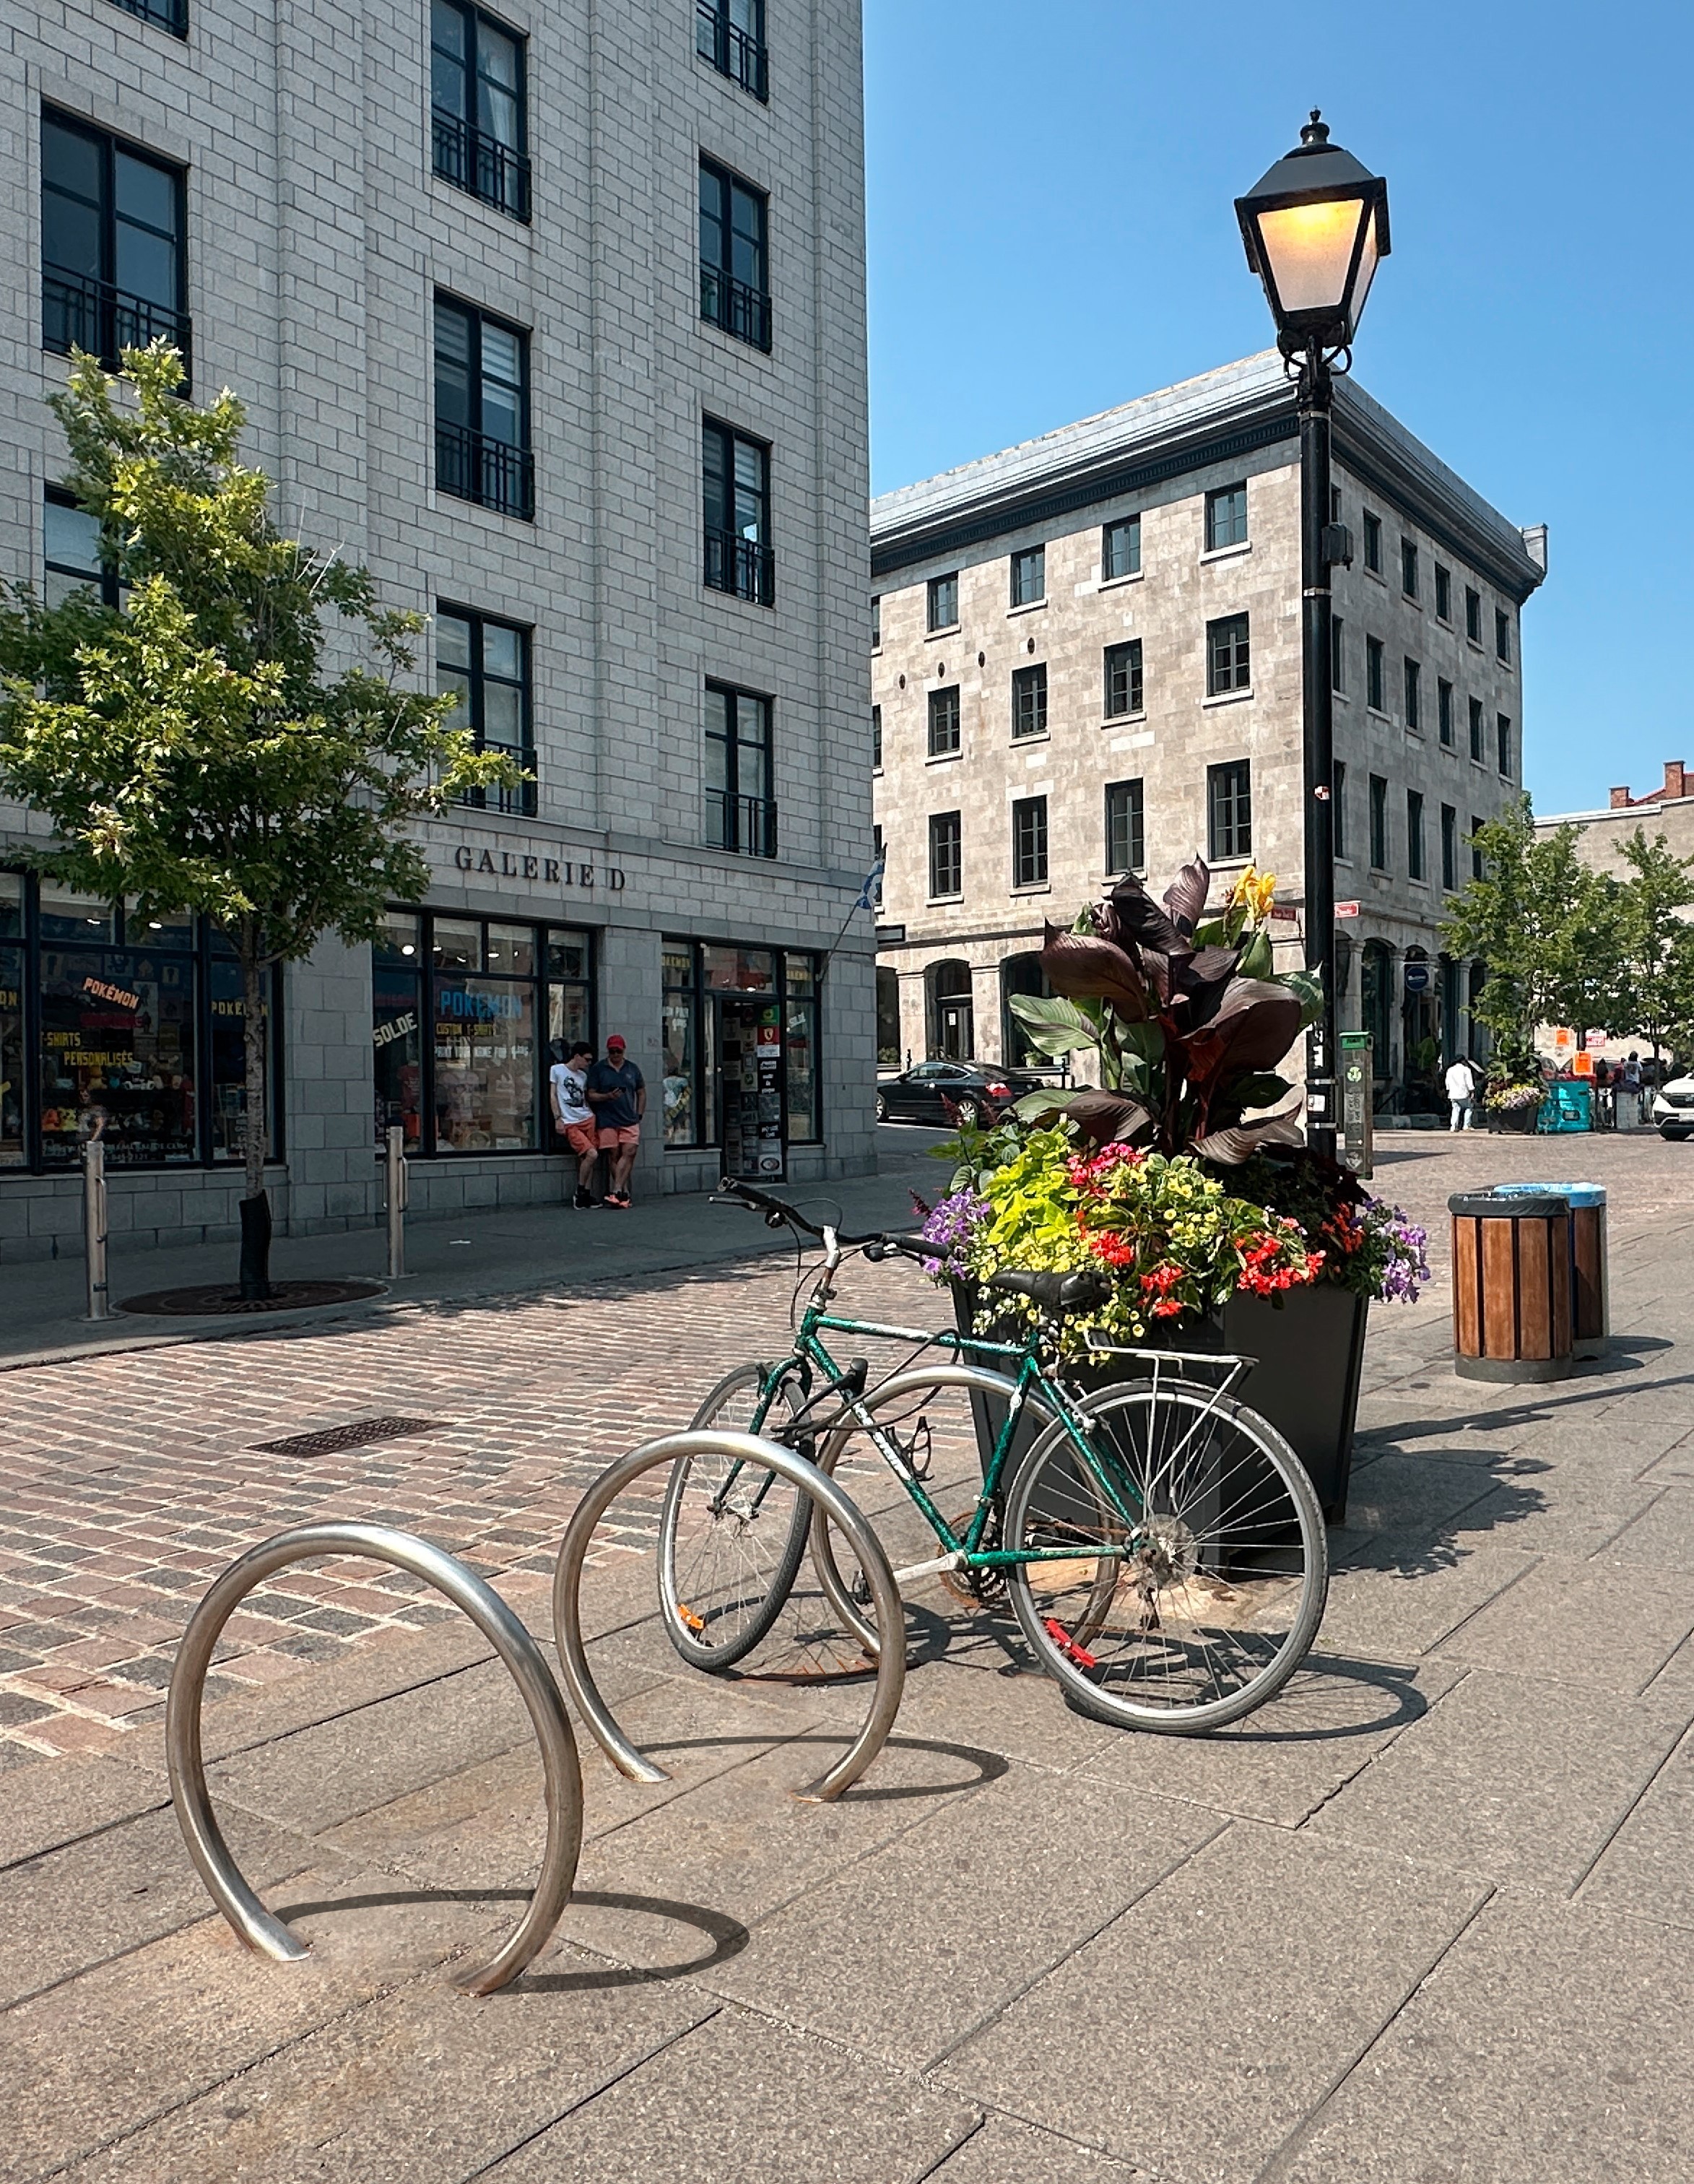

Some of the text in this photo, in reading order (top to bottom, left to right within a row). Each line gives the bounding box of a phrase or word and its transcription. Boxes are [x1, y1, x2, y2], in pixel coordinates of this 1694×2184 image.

[455, 845, 626, 891] GALERIE D
[82, 976, 139, 1010] POKÉMON
[211, 1001, 269, 1017] POKEN
[373, 1011, 417, 1047] SOLDE
